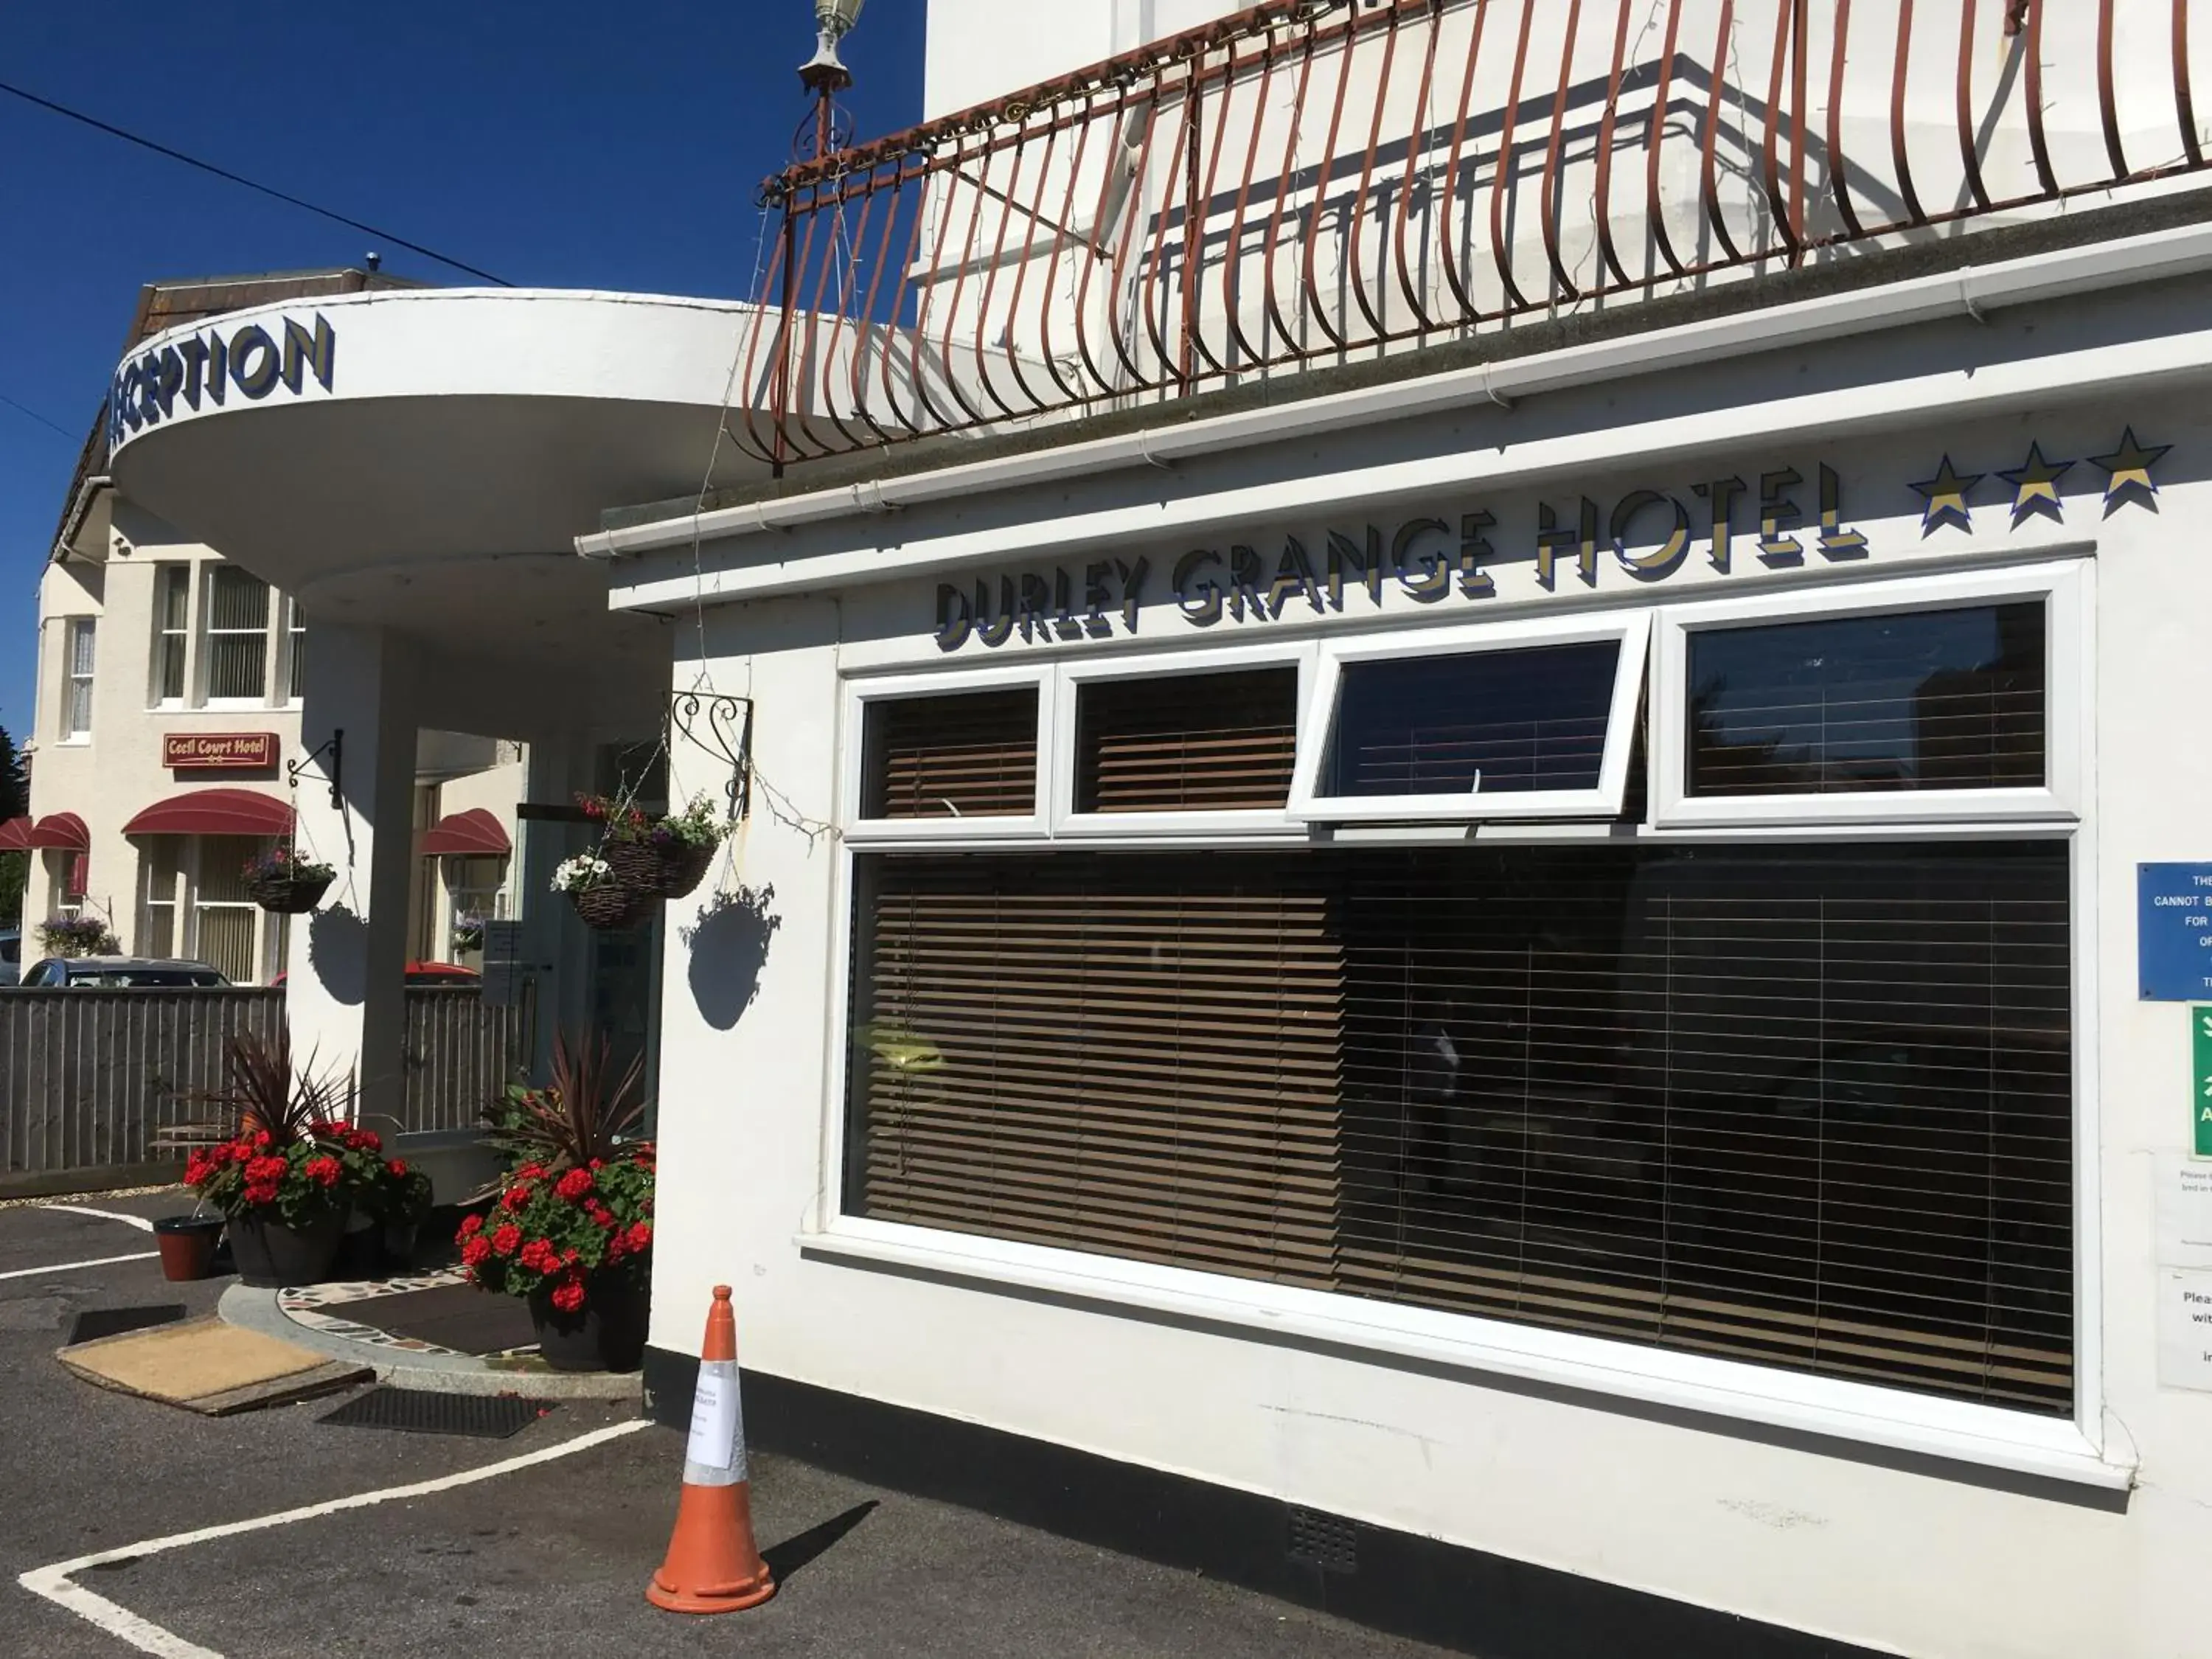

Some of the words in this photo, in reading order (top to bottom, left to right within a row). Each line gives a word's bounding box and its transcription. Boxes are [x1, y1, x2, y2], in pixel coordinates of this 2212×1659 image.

[936, 554, 1149, 653] DURLEY
[1172, 509, 1497, 628] GRANGE
[1534, 462, 1870, 590] HOTEL
[168, 738, 195, 754] Cecil
[198, 739, 232, 754] Court
[233, 737, 265, 754] Hotel
[2154, 896, 2200, 906] CANNOT
[2185, 916, 2208, 927] FOR
